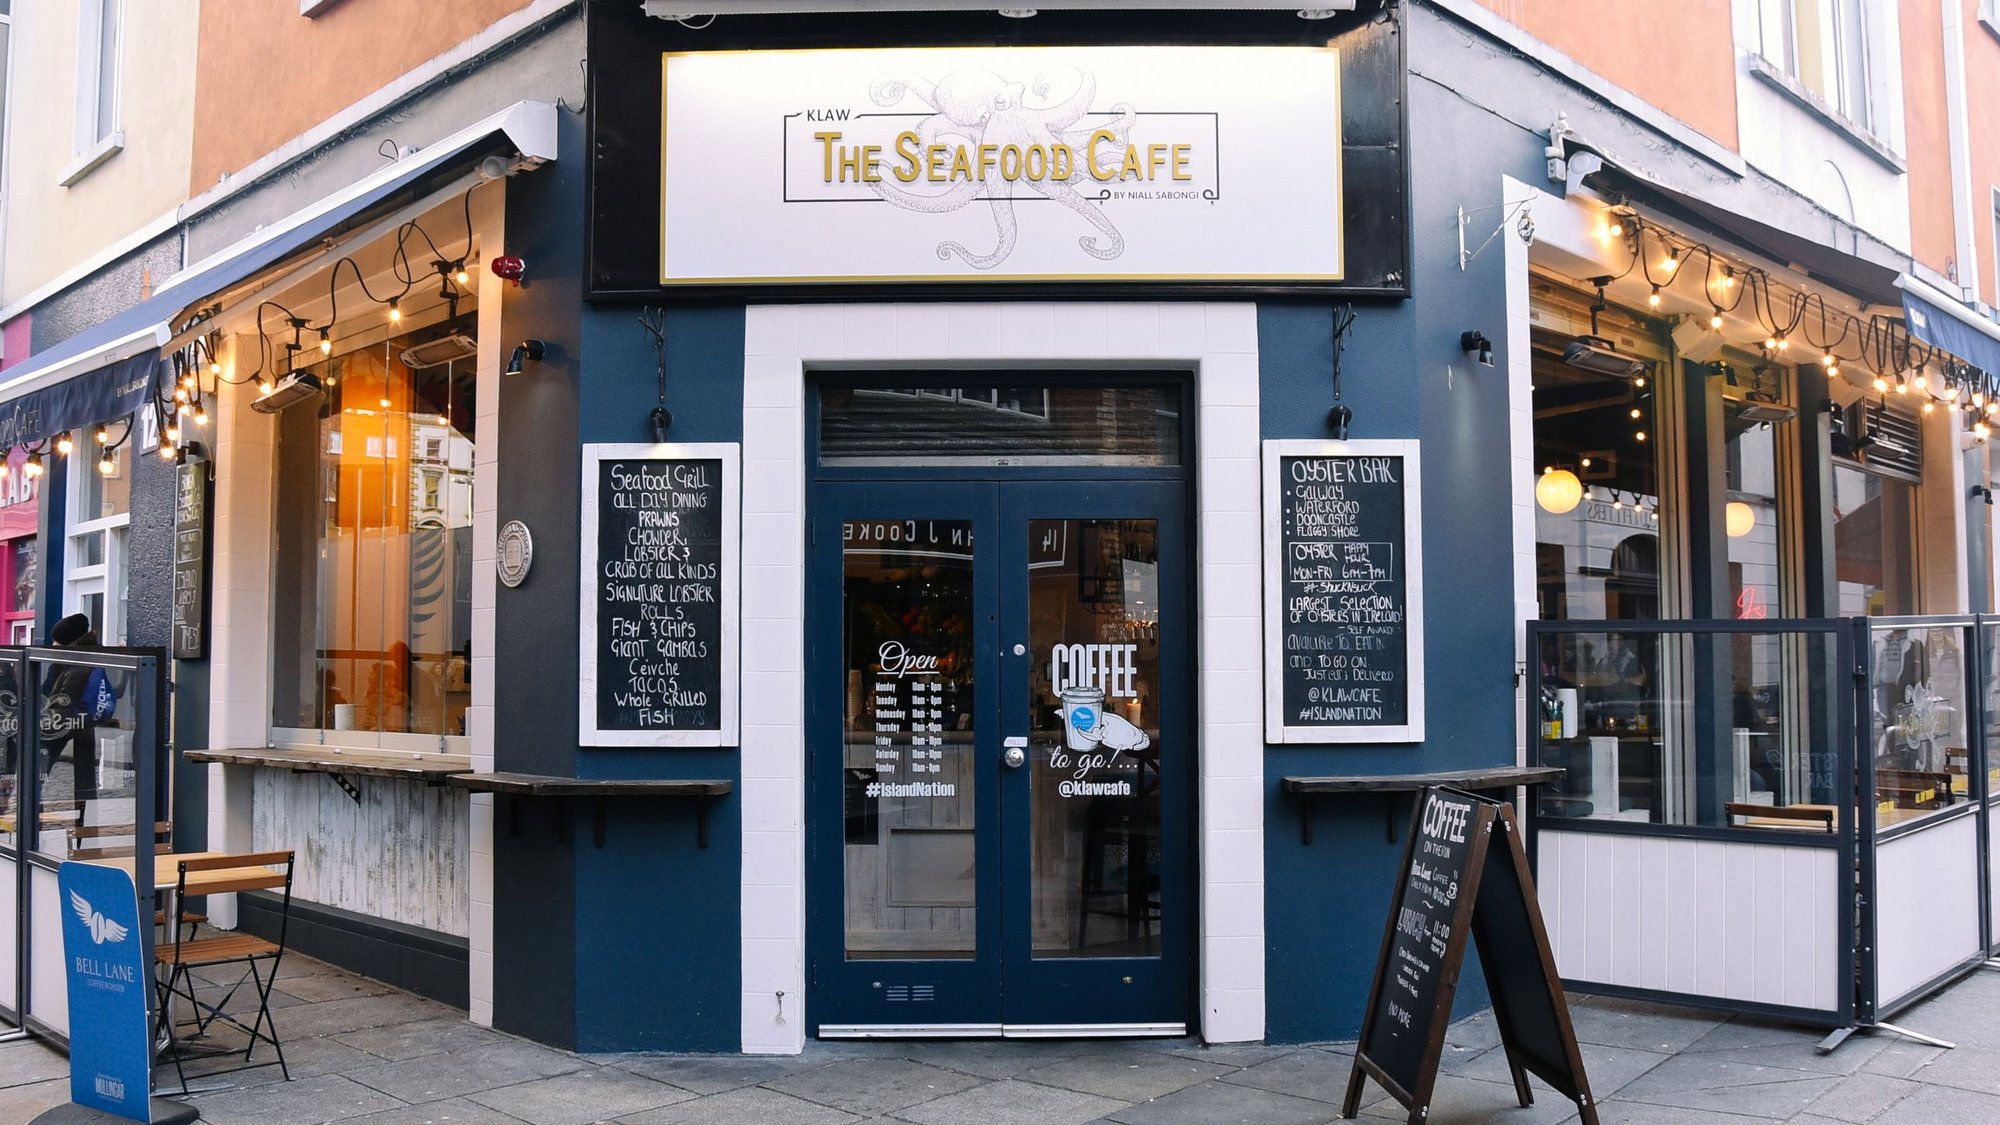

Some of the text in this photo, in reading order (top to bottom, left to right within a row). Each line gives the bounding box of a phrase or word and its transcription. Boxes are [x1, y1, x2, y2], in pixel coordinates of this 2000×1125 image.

[806, 108, 851, 122] KLAW
[814, 129, 1193, 183] THE SEAFOOD CAFE
[1113, 190, 1200, 201] BY NIALL SABONGI
[610, 464, 673, 490] Seafood
[1291, 457, 1398, 483] OYSTER BAR
[672, 492, 708, 509] DINING
[1295, 500, 1360, 515] WATERFORD
[639, 510, 680, 528] PRAWNS
[1331, 525, 1360, 538] SHORE
[624, 545, 681, 562] LOBSTER
[1295, 543, 1370, 561] OYSTER HAPPY
[1344, 553, 1371, 564] HOUR
[605, 560, 638, 579] CRAB
[640, 562, 654, 579] OF
[678, 562, 717, 580] KINDS
[1293, 565, 1334, 581] MON-FRI
[669, 582, 715, 603] LOBSTER
[640, 603, 684, 620] ROLLS
[1290, 595, 1393, 612] LARGEST SELECTION
[1290, 610, 1304, 623] OF
[1307, 609, 1349, 623] OYSTERS
[1352, 610, 1361, 623] IN
[612, 617, 641, 638] FISH
[660, 619, 697, 638] CHIPS
[1347, 624, 1365, 635] SELF
[656, 638, 707, 658] GAMBAS
[878, 640, 939, 679] Open
[1318, 654, 1332, 669] TO
[1333, 655, 1348, 669] GO
[1351, 655, 1368, 669] ON
[1051, 643, 1138, 698] COFFEE
[1303, 668, 1328, 681] JUST
[628, 676, 678, 693] TACOS
[876, 682, 897, 694] Monday
[613, 692, 652, 707] Whole
[876, 695, 898, 707] Tuesday
[1308, 686, 1383, 703] @KLAWCAFE
[638, 708, 675, 727] FISH
[876, 709, 907, 721] Wednesday
[1299, 706, 1382, 721] #ISLANDNATION
[876, 722, 901, 734] Thursday
[876, 736, 892, 748] Friday
[876, 749, 900, 761] Saturday
[1050, 745, 1072, 769] to
[876, 763, 896, 775] Sunday
[865, 781, 956, 798] #IslandNation
[1058, 780, 1132, 798] @klawcafe
[1422, 794, 1471, 844] COFFEE
[76, 957, 135, 983] BELL LANE
